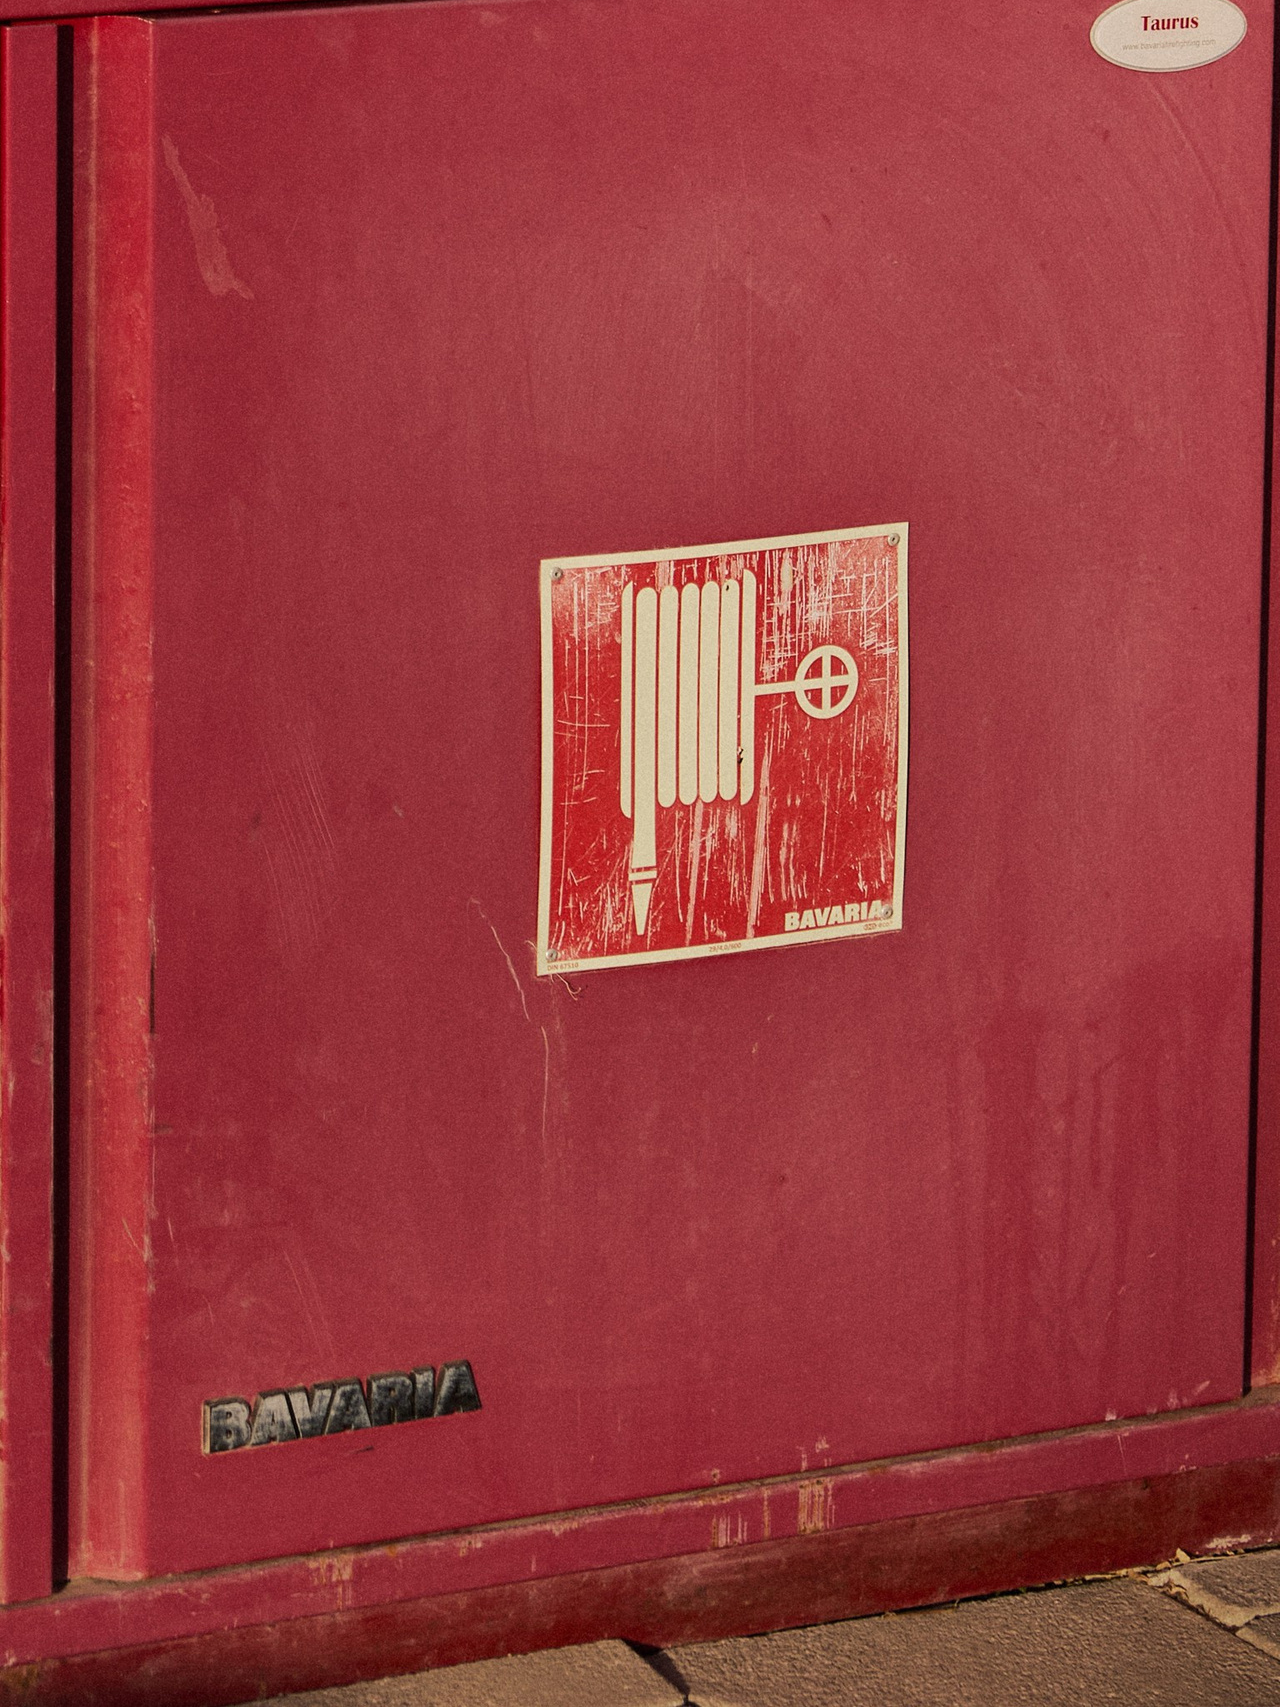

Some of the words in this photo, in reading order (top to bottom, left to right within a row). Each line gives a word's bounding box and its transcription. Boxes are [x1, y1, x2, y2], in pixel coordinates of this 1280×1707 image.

[1141, 15, 1199, 32] Taurus
[784, 899, 883, 932] BAVARIA
[547, 964, 559, 972] DIN
[201, 1359, 483, 1457] BAVARIA
